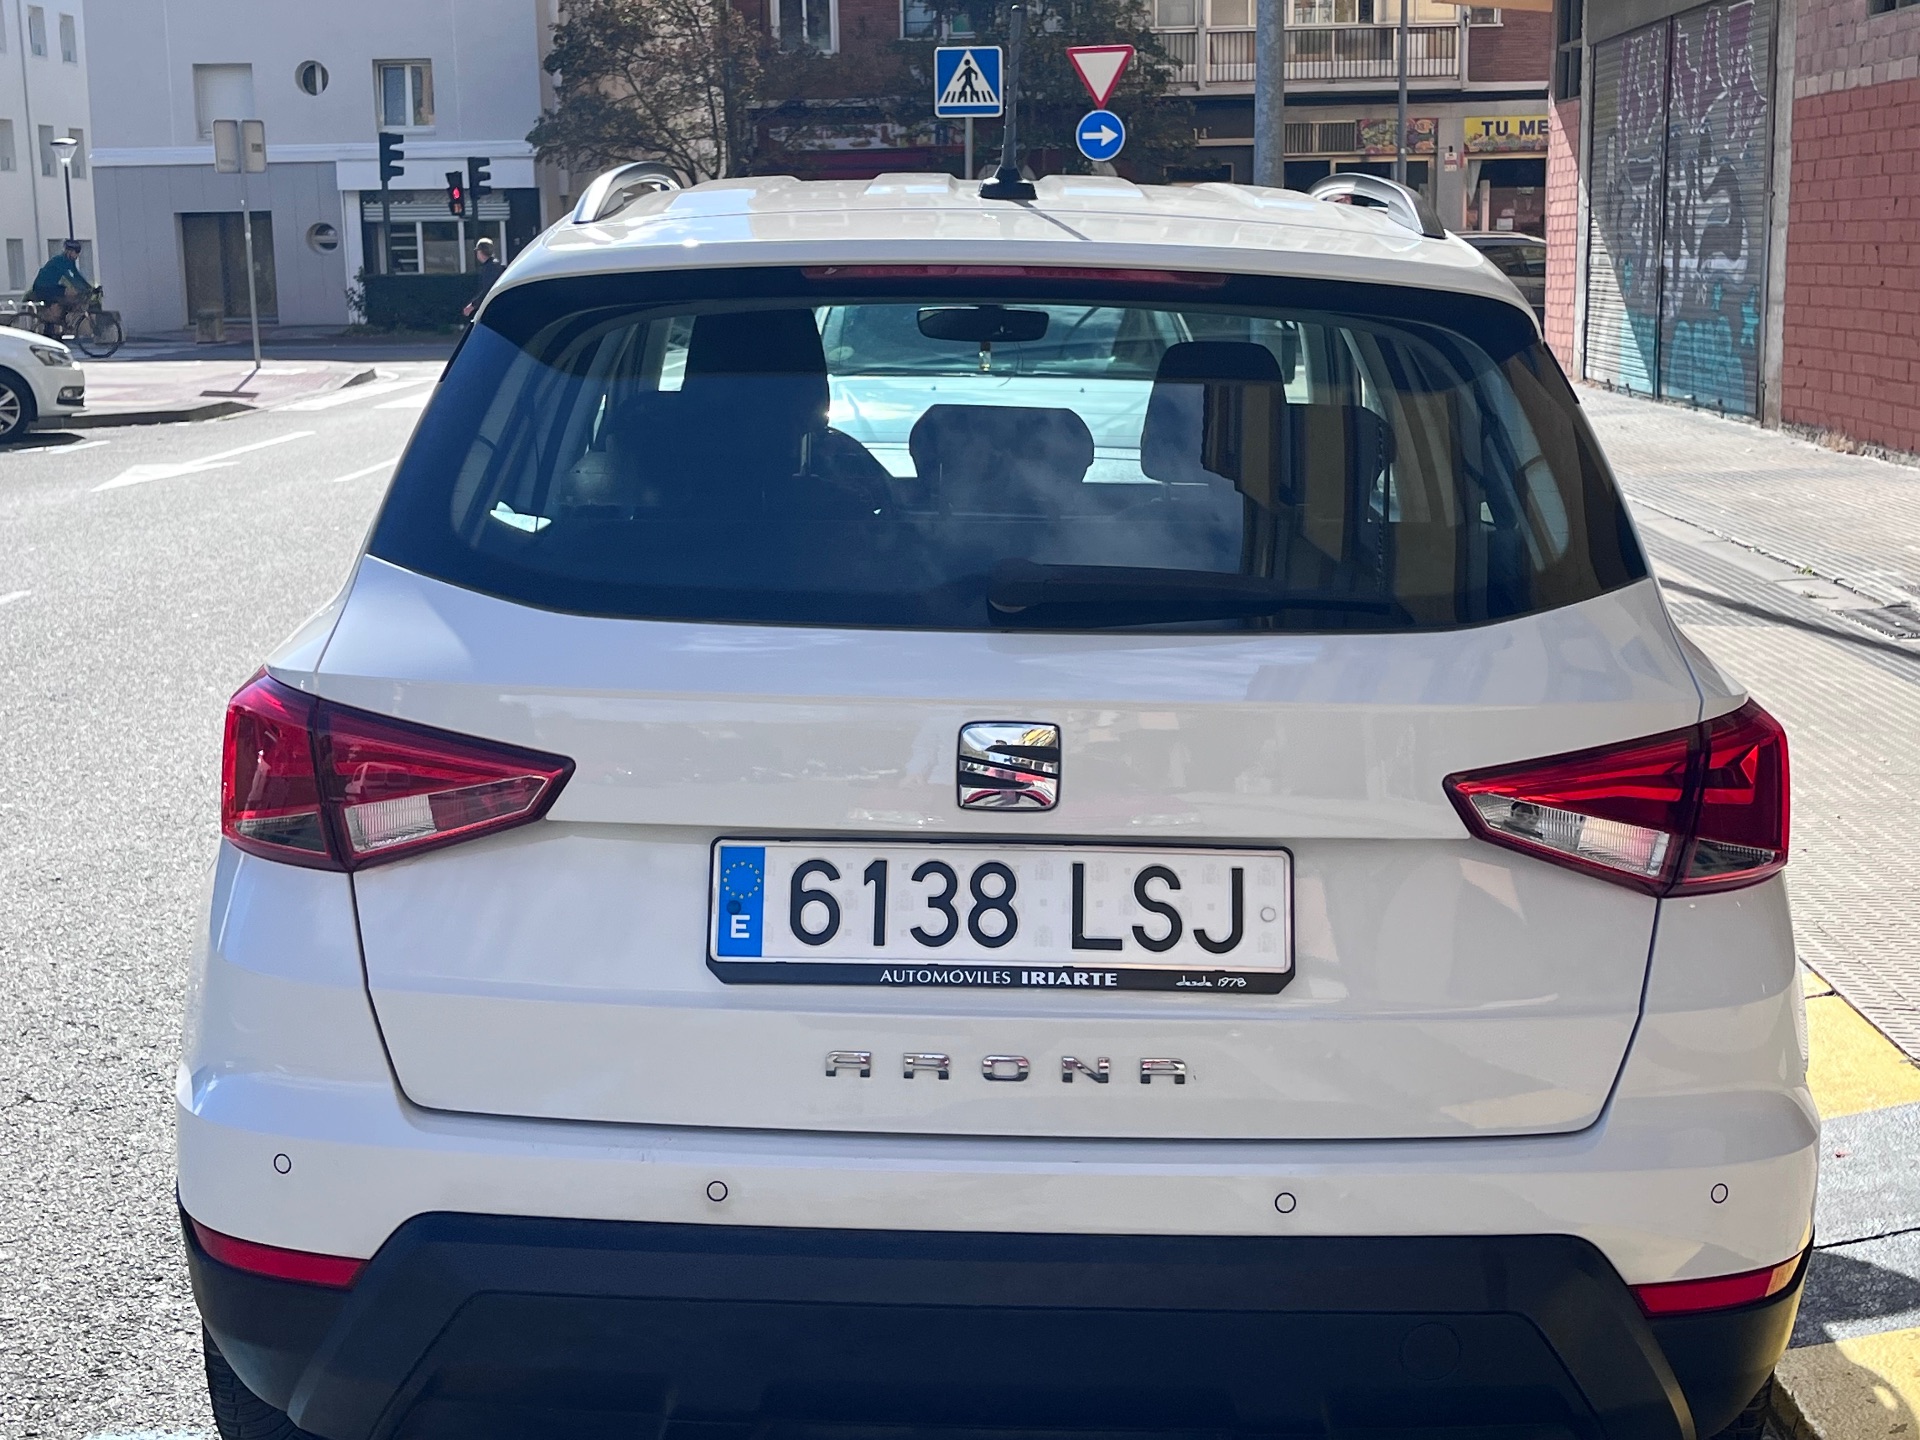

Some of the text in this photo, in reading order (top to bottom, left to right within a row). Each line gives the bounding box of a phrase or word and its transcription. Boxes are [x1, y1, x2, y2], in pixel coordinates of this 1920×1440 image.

[1481, 121, 1508, 136] TU
[790, 859, 1244, 954] 6138 LSJ
[730, 914, 750, 939] E
[1021, 970, 1118, 987] IRIARTE
[1176, 975, 1213, 987] desde
[1217, 976, 1247, 988] 1978
[825, 1049, 1188, 1085] ARONA
